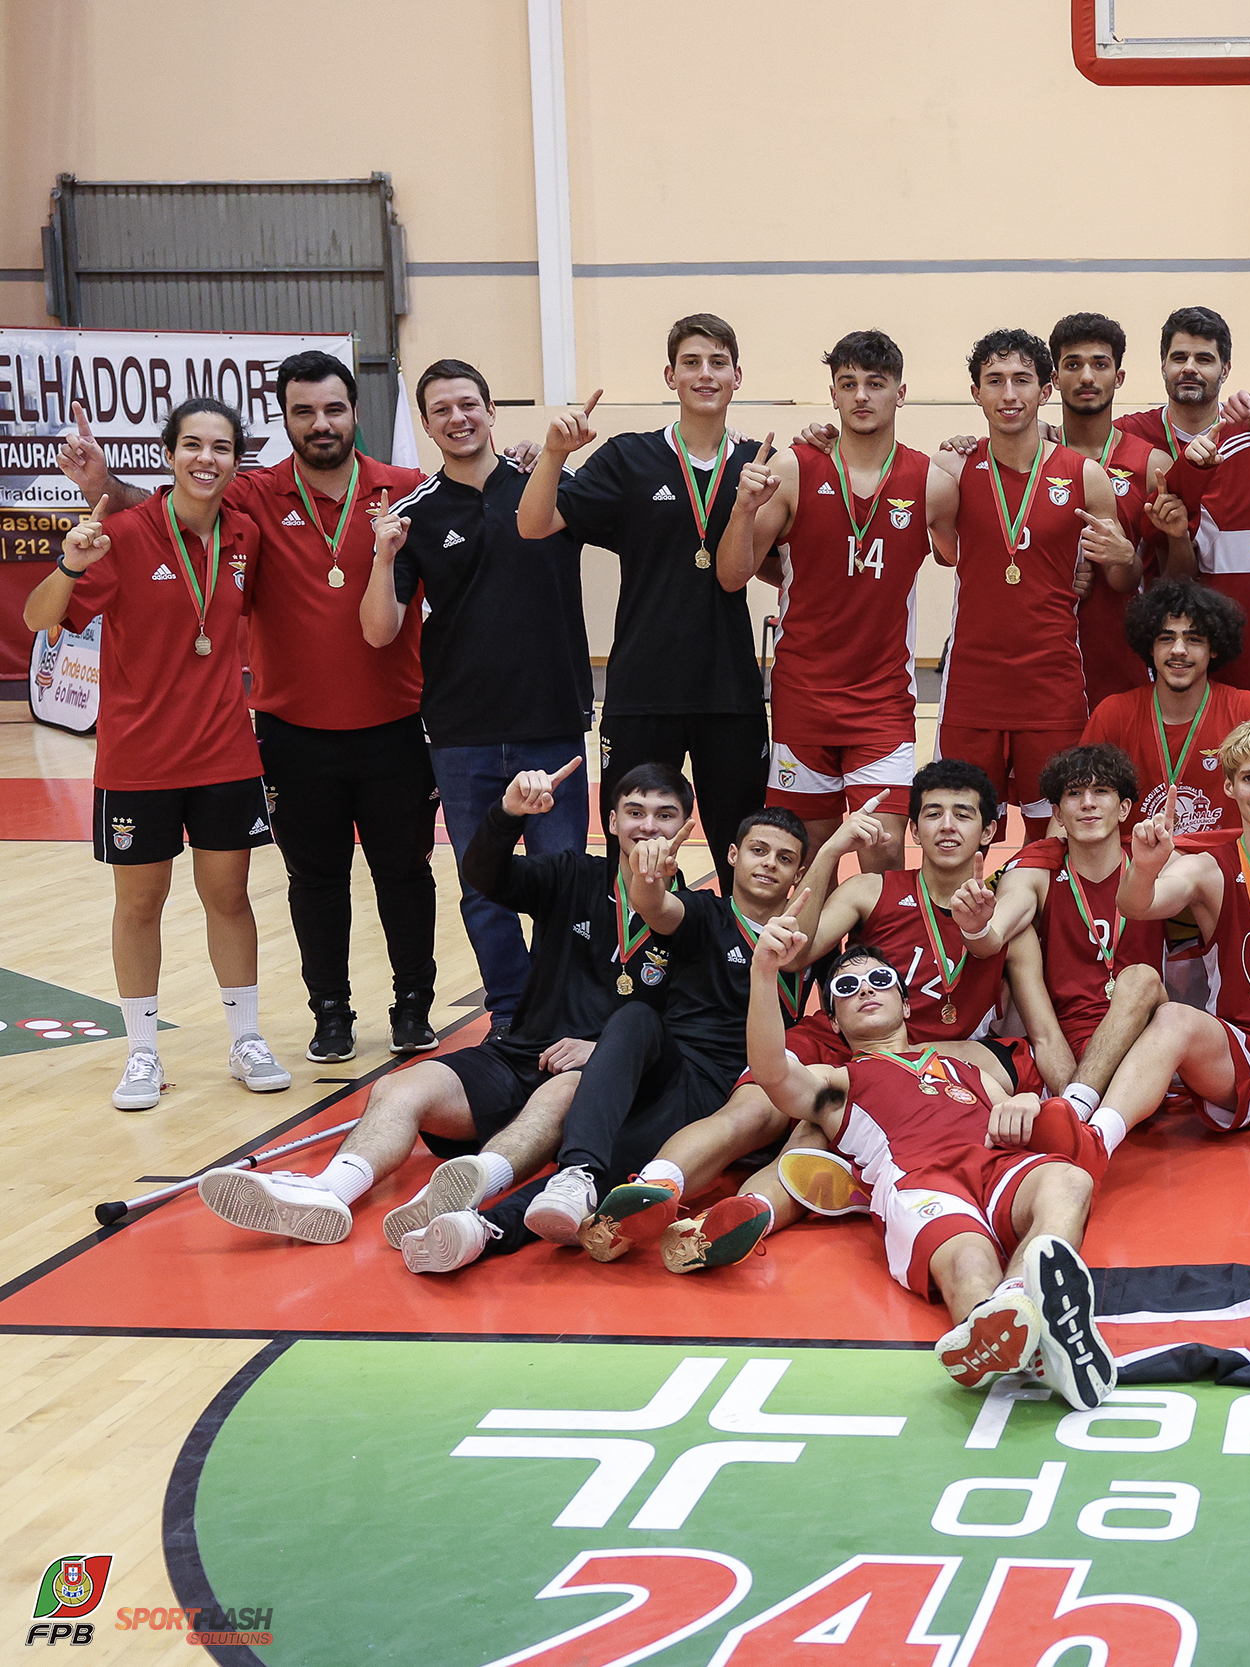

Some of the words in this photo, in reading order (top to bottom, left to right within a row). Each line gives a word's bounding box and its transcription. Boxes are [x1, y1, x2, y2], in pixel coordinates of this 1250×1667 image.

[14, 538, 50, 555] 212
[442, 536, 465, 549] adidas
[847, 535, 885, 580] 14
[151, 573, 177, 581] adidas
[61, 656, 80, 681] Onde
[65, 684, 91, 710] limite!
[1088, 919, 1111, 961] 9
[903, 945, 956, 1000] 12
[930, 1462, 1202, 1543] da
[478, 1547, 1200, 1667] 24h
